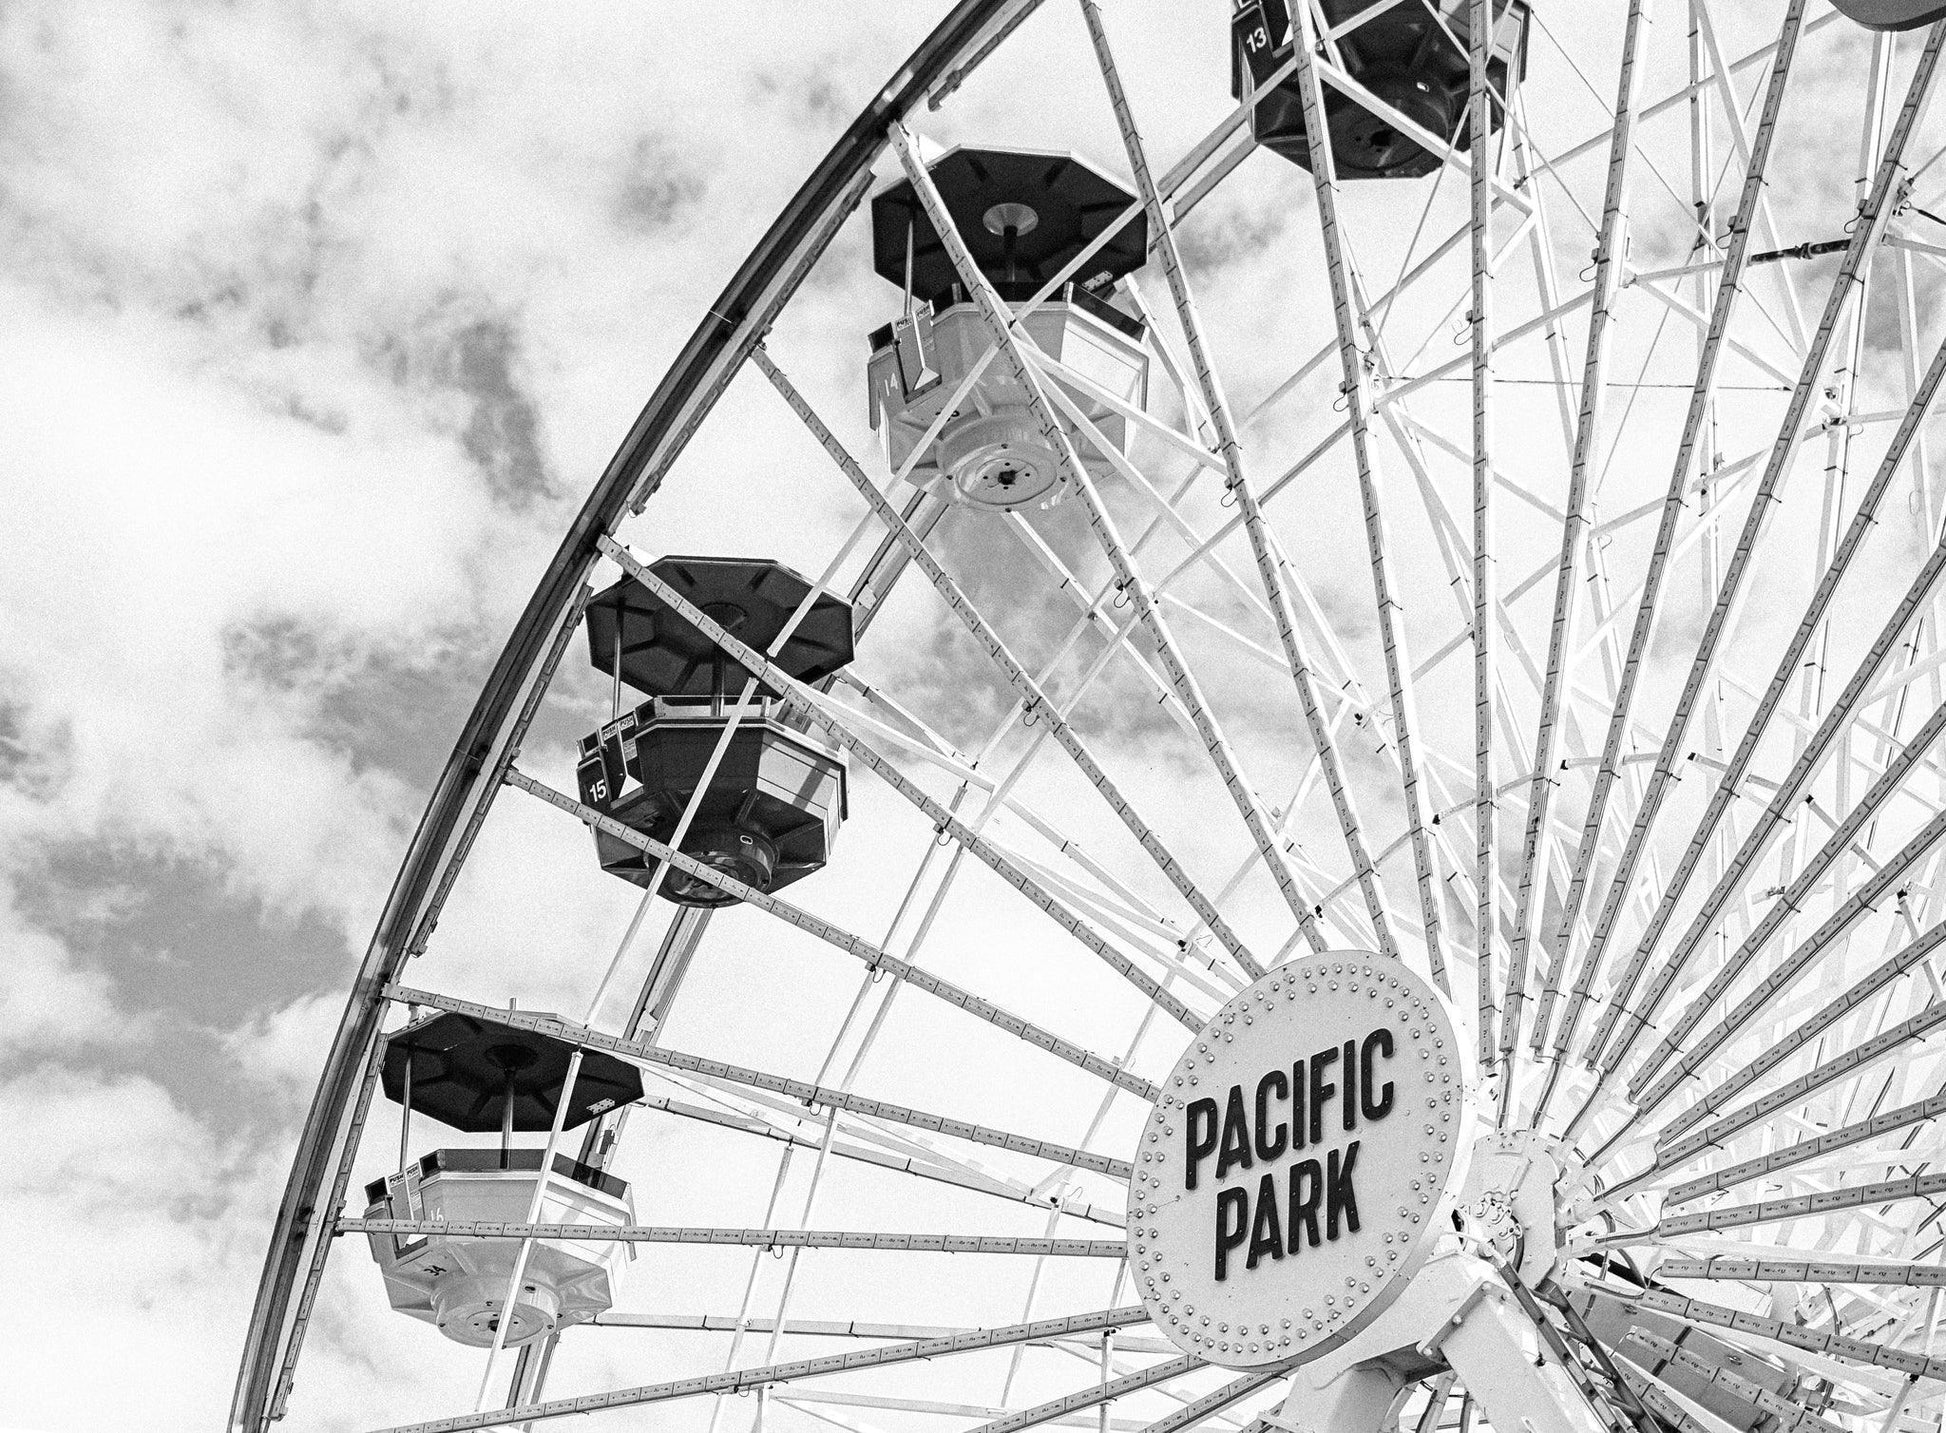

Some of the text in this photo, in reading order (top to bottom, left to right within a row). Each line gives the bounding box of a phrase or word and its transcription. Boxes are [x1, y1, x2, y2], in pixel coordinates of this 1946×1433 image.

[1246, 27, 1267, 53] 13
[884, 372, 899, 397] 14
[589, 778, 607, 803] 15
[1185, 1027, 1395, 1191] PACIFIC
[1214, 1140, 1361, 1282] PARK
